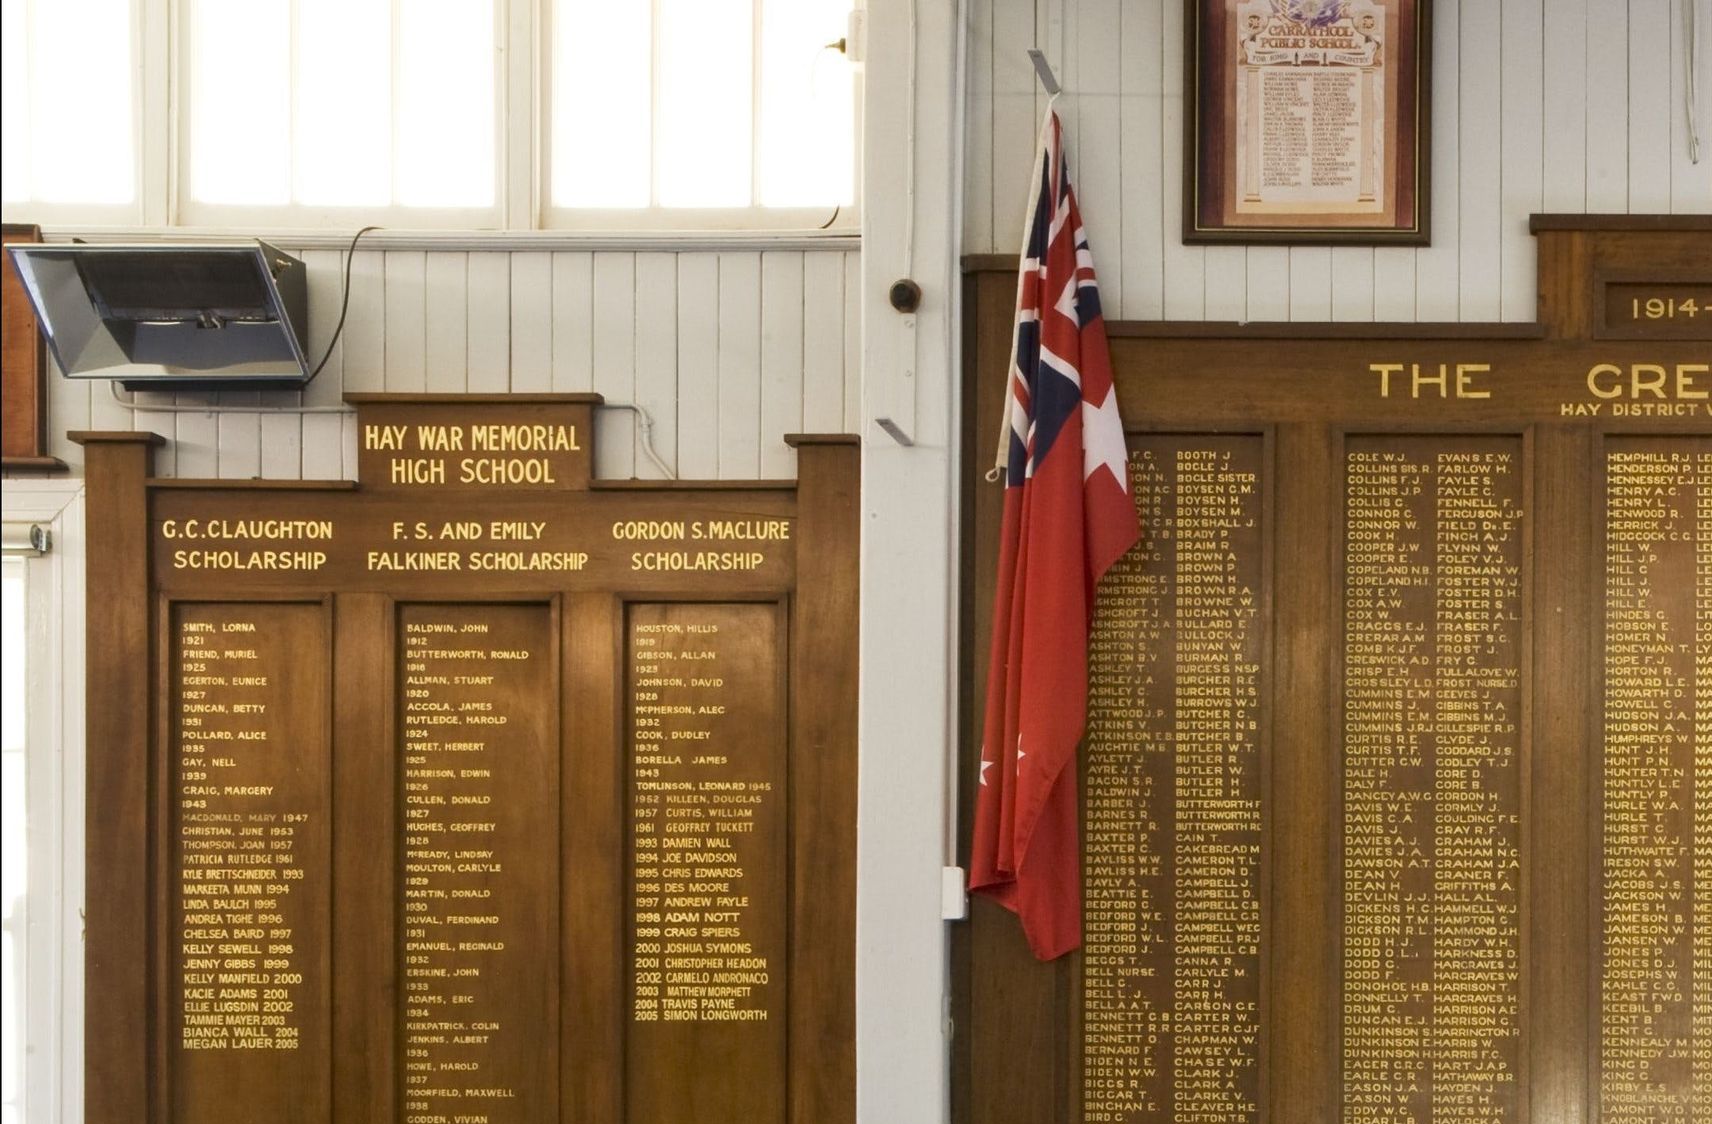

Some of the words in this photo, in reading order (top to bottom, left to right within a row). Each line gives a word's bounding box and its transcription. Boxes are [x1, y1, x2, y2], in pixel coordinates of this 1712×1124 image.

[1370, 364, 1490, 398] THE
[1561, 404, 1601, 415] HAY
[1613, 404, 1698, 416] DISTRICT
[366, 426, 407, 449] HAY
[418, 426, 463, 450] WAR
[472, 426, 580, 450] MEMORIAL
[392, 459, 444, 483] HIGH
[460, 459, 554, 483] SCHOOL
[1437, 464, 1492, 474] FARLOW
[1437, 498, 1498, 508] FENNELL
[1607, 497, 1653, 507] HENRY
[394, 523, 407, 539] F.
[415, 523, 433, 539] S.
[440, 523, 482, 539] AND
[491, 522, 545, 539] EMILY
[613, 522, 684, 539] GORDON
[174, 551, 326, 569] SCHOLARSHIP
[368, 552, 461, 570] FALKINER
[469, 553, 588, 570] SCHOLARSHIP
[632, 553, 763, 570] SCHOLARSHIP
[222, 623, 256, 632] LORNA
[406, 624, 458, 634] BALDWIN,
[460, 624, 489, 633] JOHN
[1606, 621, 1657, 631] HOBSON
[182, 635, 205, 646] 1921
[183, 649, 220, 660] FRIEND,
[224, 649, 258, 659] MURIEL
[406, 650, 487, 660] BUTTERWORTH,
[490, 650, 529, 660] RONALD
[690, 678, 724, 688] DAVID
[183, 704, 229, 714] DUNCAN,
[232, 704, 266, 714] BETTY
[458, 702, 493, 711] JAMES
[406, 729, 429, 738] 1924
[636, 852, 659, 863] 1994
[662, 852, 682, 864] JOE
[685, 852, 737, 863] DAVIDSON
[636, 897, 660, 908] 1997
[663, 897, 712, 907] ANDREW
[716, 896, 749, 907] FAYLE
[182, 943, 215, 955] KELLY
[218, 944, 263, 955] SEWELL
[268, 944, 294, 954] 1998
[1433, 949, 1503, 959] HARKNESS
[183, 958, 222, 969] JENNY
[224, 959, 256, 969] GIBBS
[263, 959, 290, 969] 1999
[184, 988, 216, 1000] KACIE
[219, 988, 258, 999] ADAMS
[263, 988, 288, 1000] 2001
[634, 1010, 659, 1021] 2005
[663, 1009, 698, 1021] SIMON
[701, 1009, 768, 1021] LONGWORTH
[183, 1038, 227, 1050] MEGAN
[231, 1037, 273, 1049] LAUER
[275, 1038, 299, 1049] 2005
[1174, 1035, 1238, 1045] CHAPMAN
[1174, 1046, 1232, 1056] CAWSEY
[1174, 1069, 1221, 1078] CLARK
